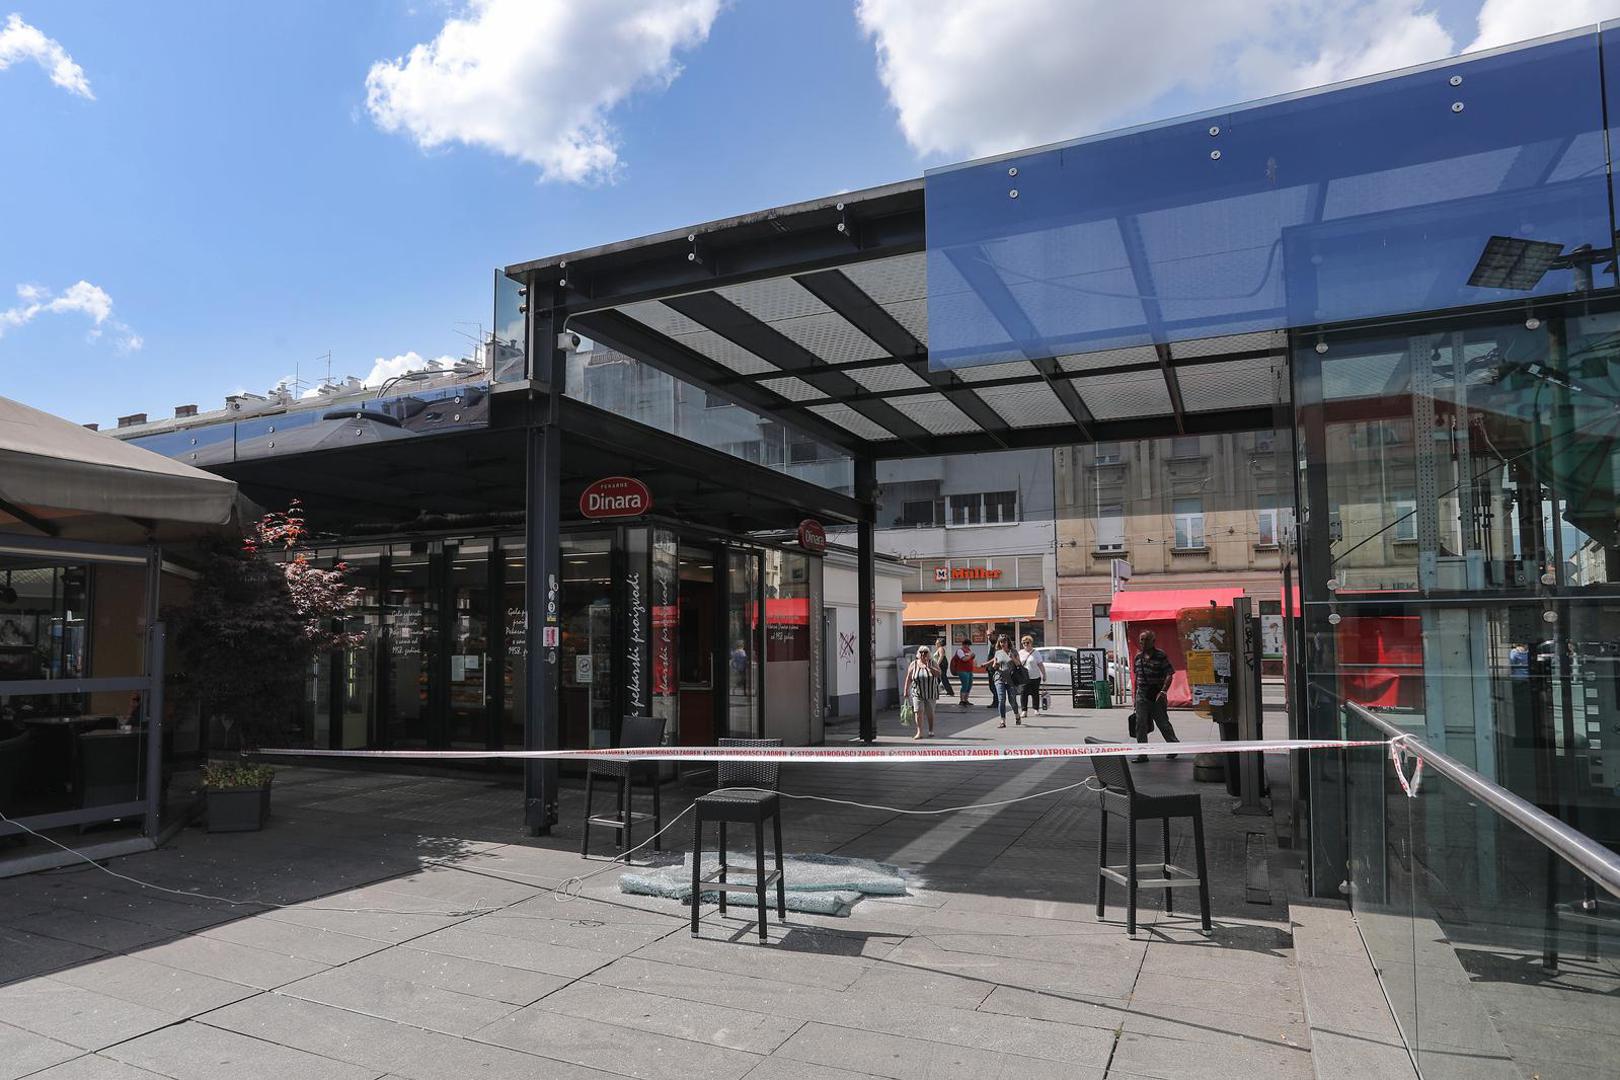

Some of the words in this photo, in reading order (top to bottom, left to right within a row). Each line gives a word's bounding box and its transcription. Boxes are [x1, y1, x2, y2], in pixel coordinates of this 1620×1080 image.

[589, 493, 642, 511] Dinara
[951, 566, 1001, 580] Müller
[626, 571, 646, 643] proizvodi
[626, 645, 646, 708] pekarski
[1013, 748, 1036, 756] STOP
